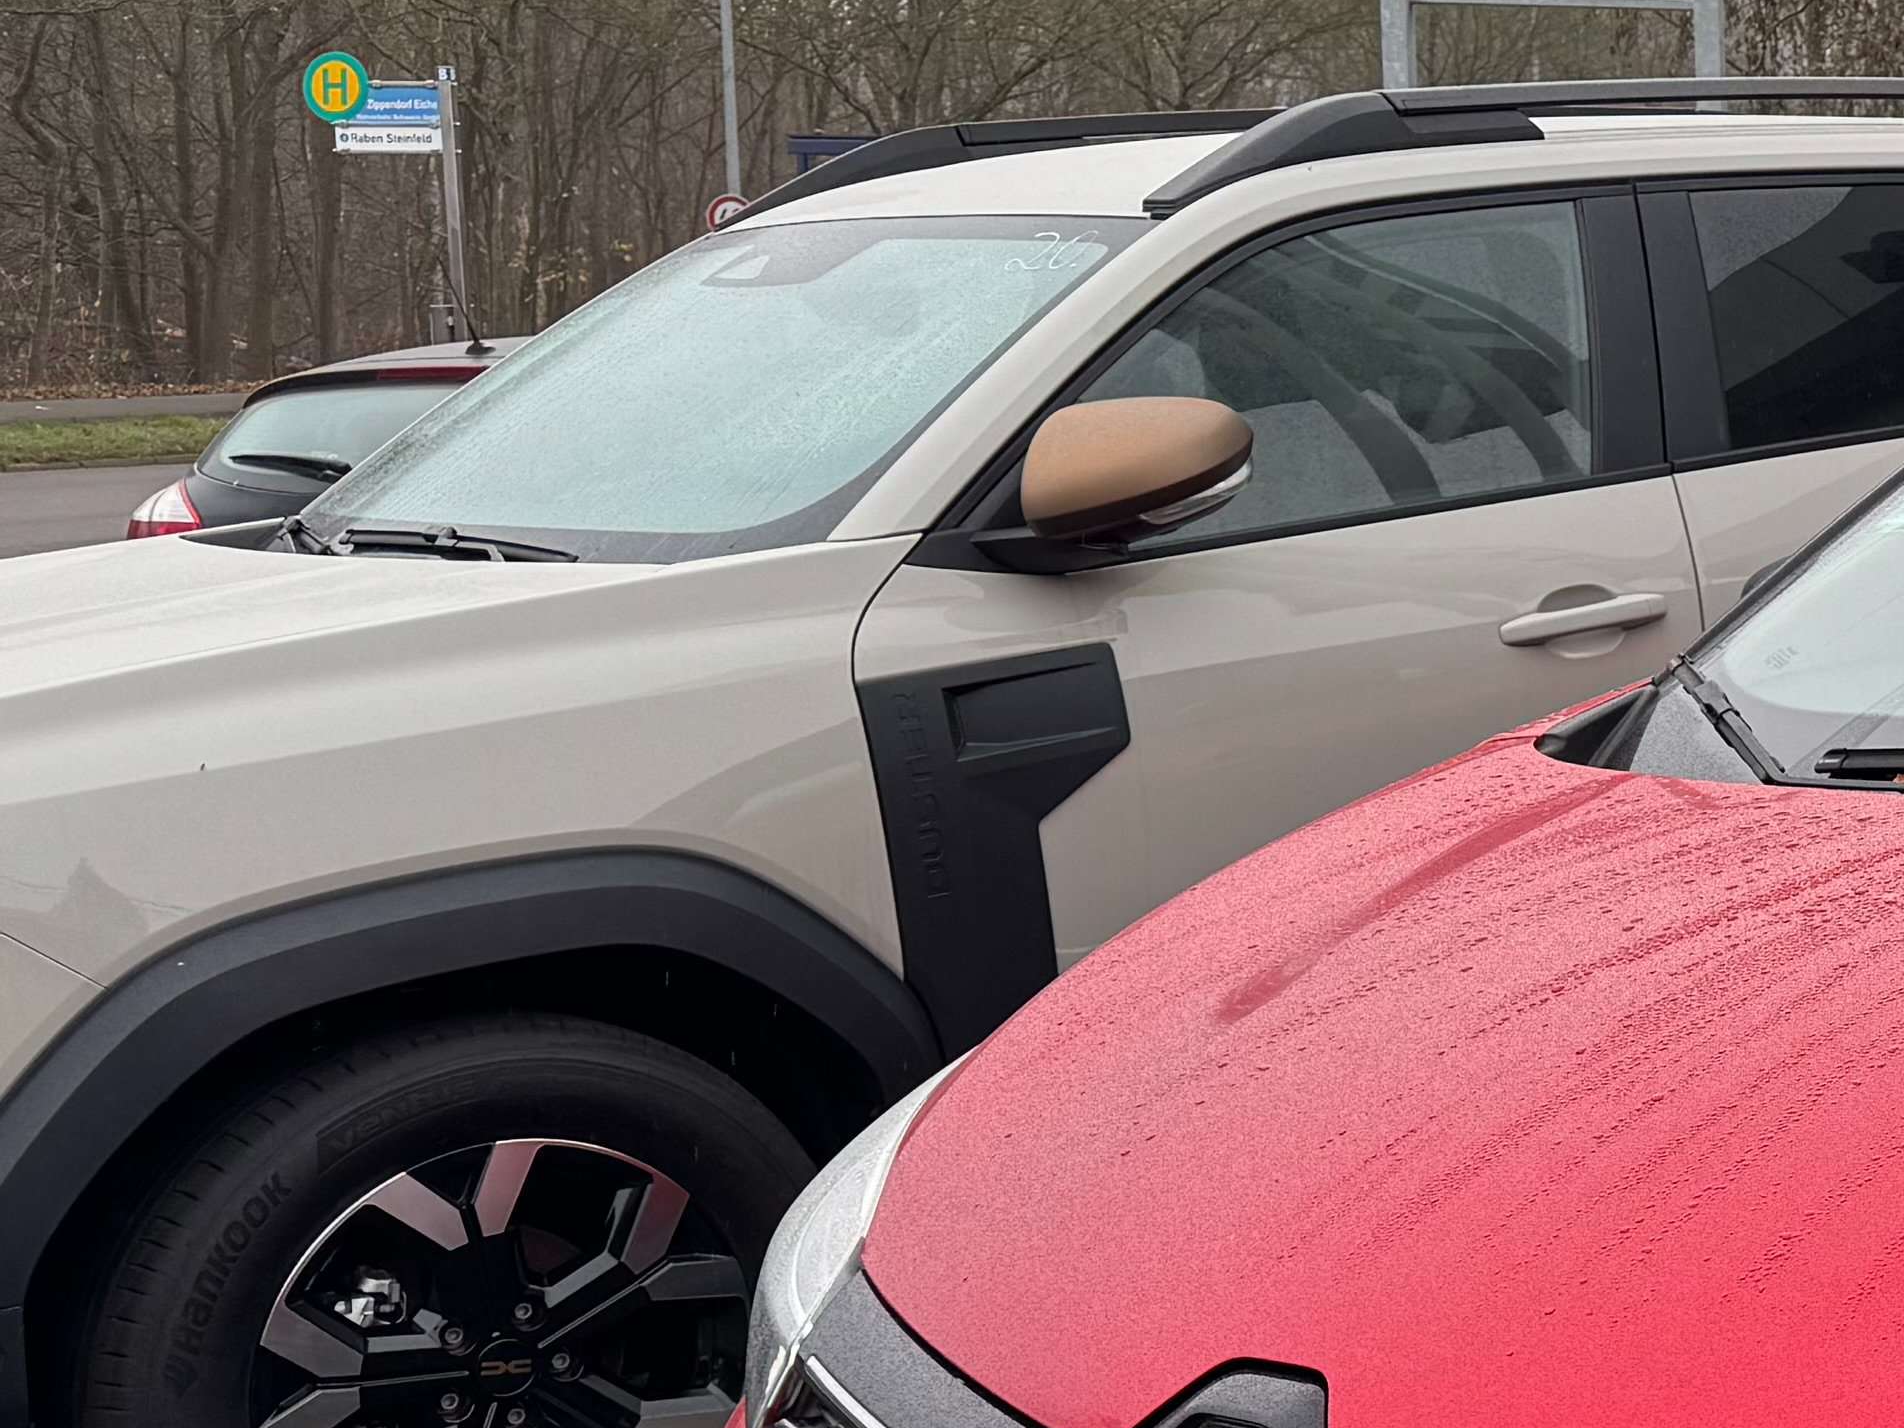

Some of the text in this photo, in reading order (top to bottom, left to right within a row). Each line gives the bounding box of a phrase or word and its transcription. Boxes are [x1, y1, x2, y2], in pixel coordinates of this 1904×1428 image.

[322, 68, 348, 106] H
[351, 133, 432, 143] Raben Steinfeld
[891, 690, 953, 899] DUSTER
